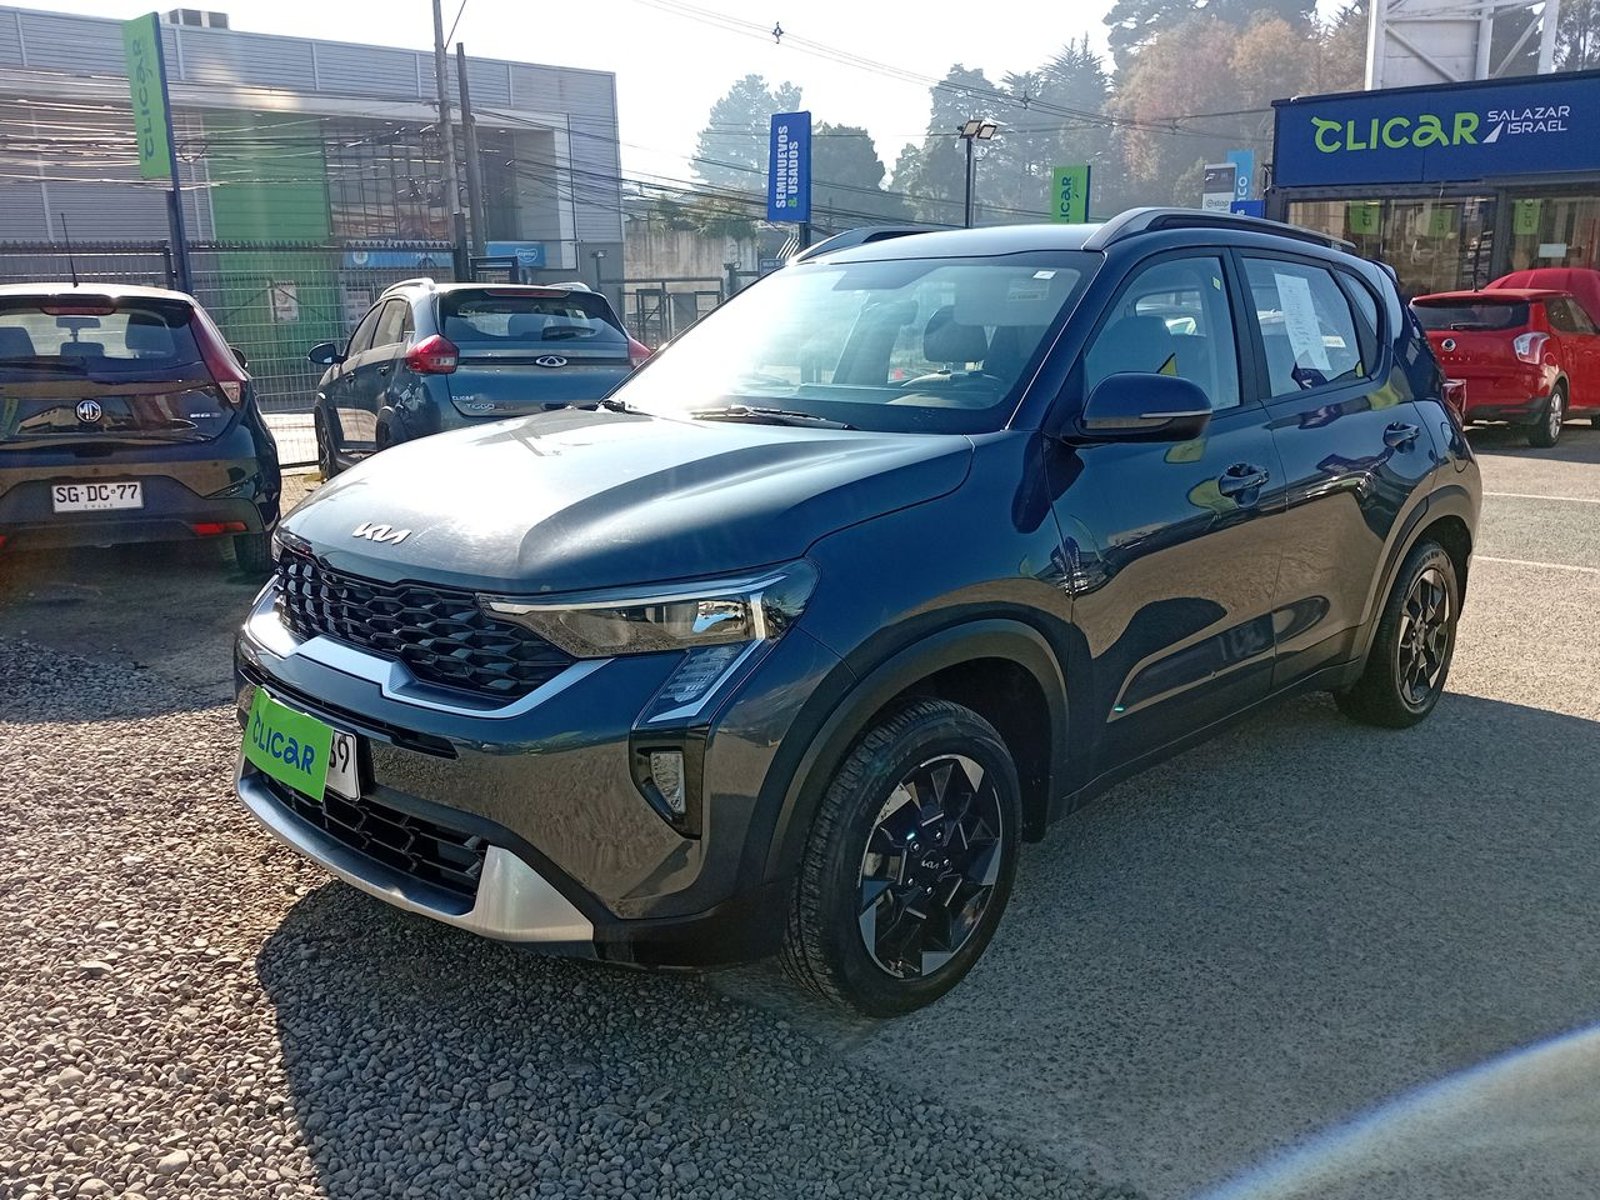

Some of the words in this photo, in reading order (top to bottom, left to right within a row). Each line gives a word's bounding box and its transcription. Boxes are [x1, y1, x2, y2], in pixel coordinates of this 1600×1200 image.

[1487, 105, 1570, 122] SALAZAR
[1507, 120, 1568, 134] ISRAEL
[776, 125, 788, 208] SEMINUEVOS
[788, 141, 799, 194] USADOS
[788, 197, 797, 208] &
[78, 402, 100, 421] MG
